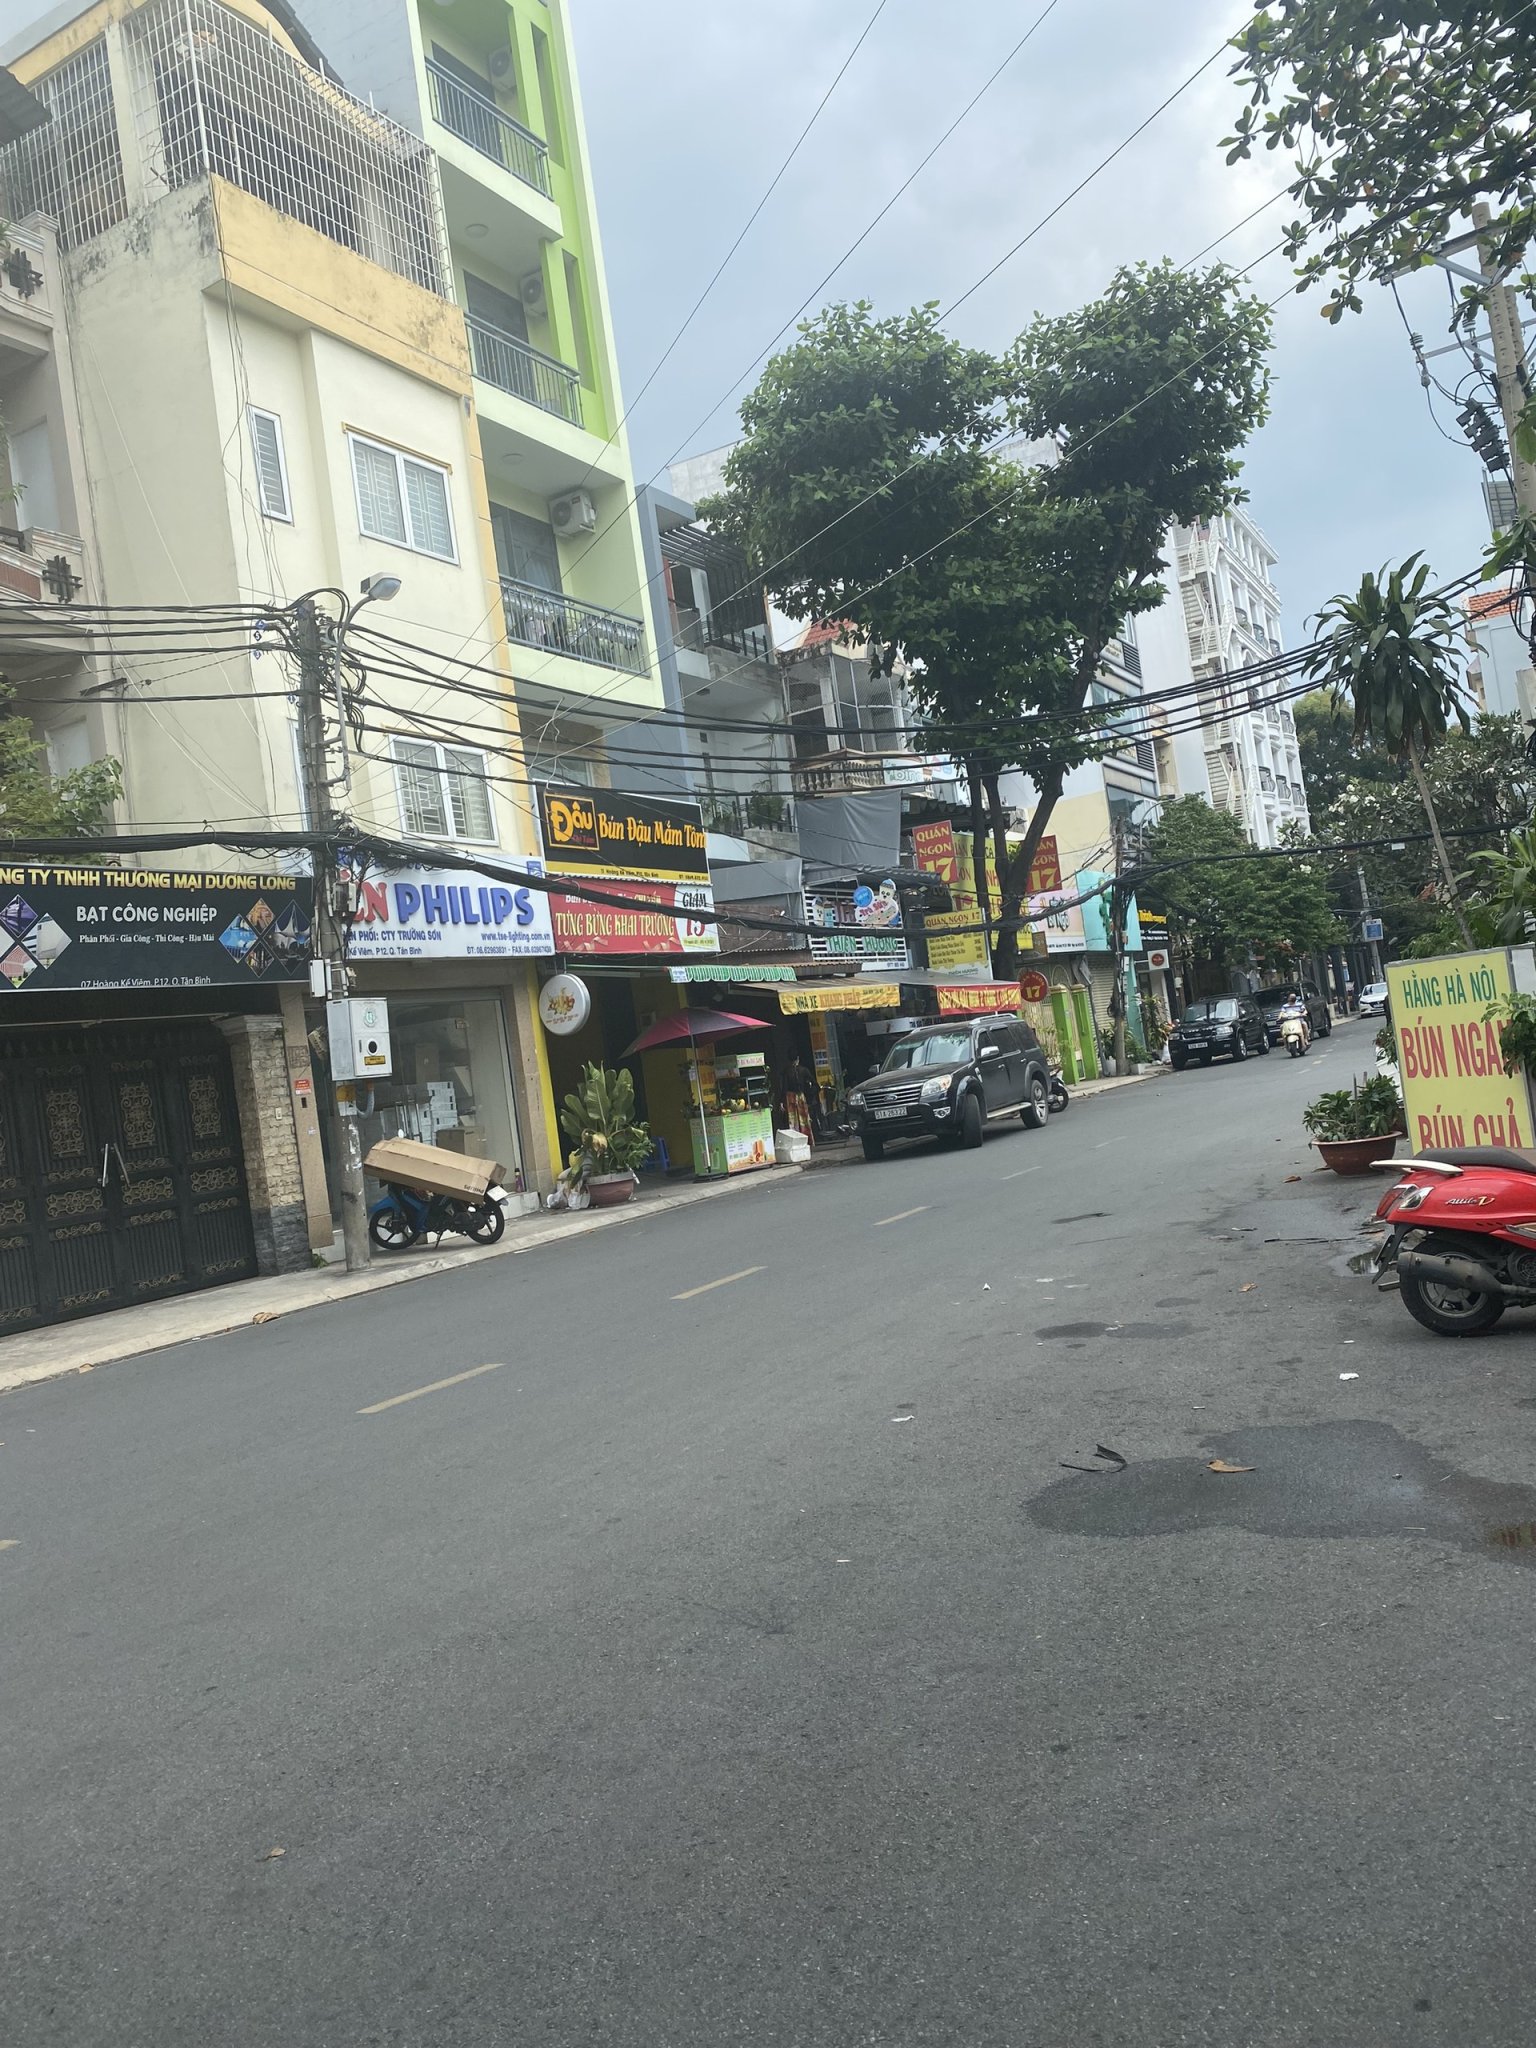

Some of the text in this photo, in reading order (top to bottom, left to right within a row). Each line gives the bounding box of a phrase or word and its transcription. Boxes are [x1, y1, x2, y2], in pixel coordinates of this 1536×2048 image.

[551, 801, 593, 843] Đậu
[598, 813, 708, 849] Bún Đậu Mắm Tôm
[916, 826, 954, 882] QUÁN NGON 17
[1032, 854, 1056, 866] GON
[28, 869, 51, 886] TY
[53, 869, 100, 887] TNHH
[104, 870, 170, 888] THƯƠNG
[174, 873, 202, 893] MẠI
[260, 876, 296, 890] LONG
[1031, 867, 1058, 891] 17
[393, 882, 535, 925] PHILIPS
[682, 889, 707, 908] GIẢM
[76, 902, 218, 925] BẠT CÔNG NGHIỆP
[614, 912, 637, 936] KHAI
[926, 917, 949, 930] QUÁN
[949, 913, 970, 925] NGON
[120, 934, 133, 943] Gia
[133, 934, 151, 945] Công
[155, 934, 167, 943] Thi
[167, 934, 184, 944] Công
[381, 930, 396, 941] CTY
[427, 929, 442, 941] SƠN
[1026, 985, 1041, 999] 17
[1402, 970, 1442, 1008] HẰNG
[1445, 968, 1467, 1005] HÀ
[809, 995, 818, 1009] XE
[1400, 1016, 1448, 1079] BÚN
[1418, 1097, 1524, 1150] BÚN CHẢ
